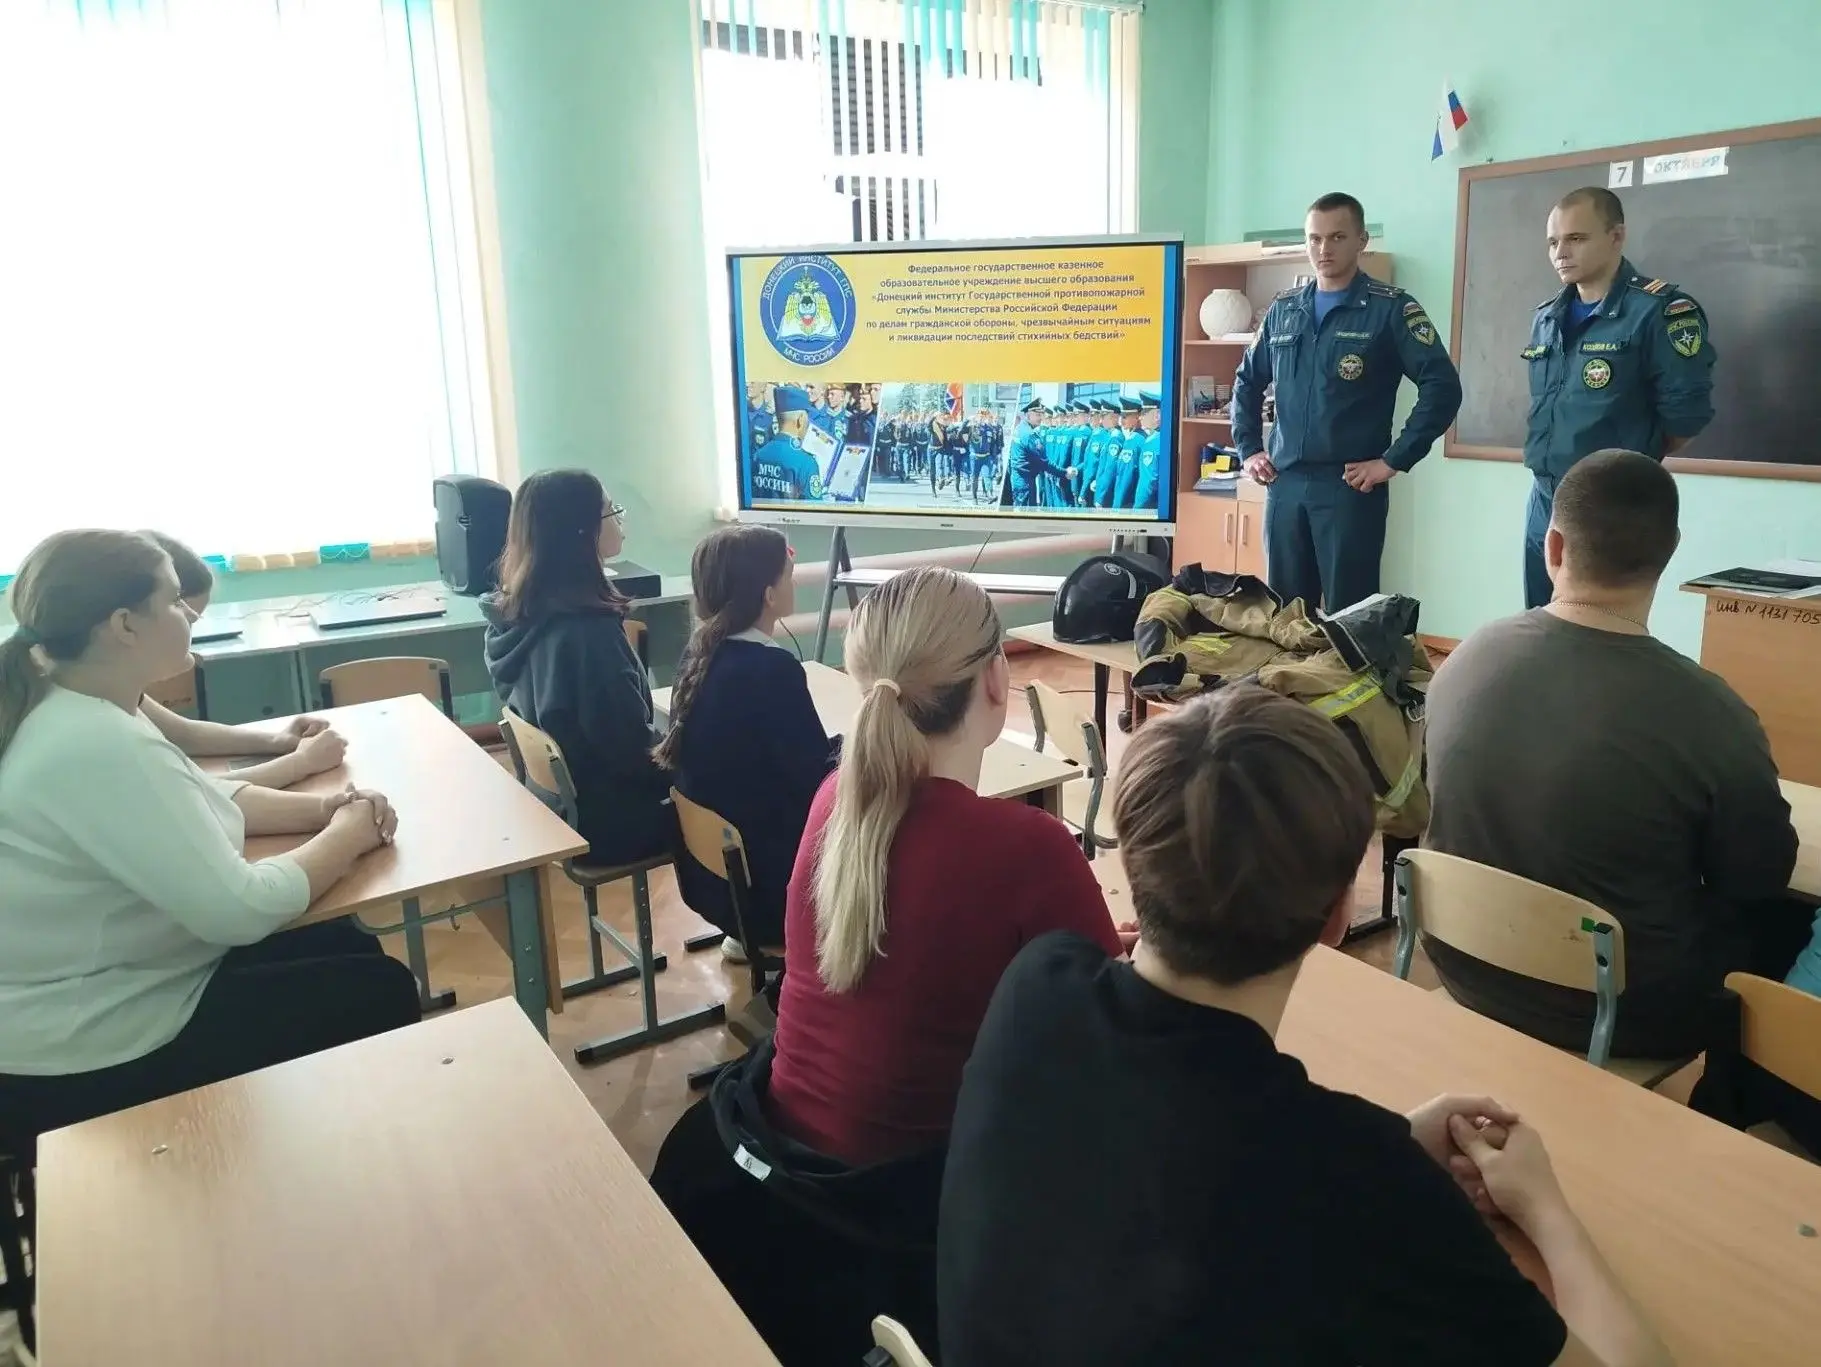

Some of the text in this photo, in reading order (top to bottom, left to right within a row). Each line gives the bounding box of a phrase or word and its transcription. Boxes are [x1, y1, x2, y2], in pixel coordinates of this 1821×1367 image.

[1616, 166, 1627, 182] 7
[908, 261, 1104, 274] Федеральное государственное казенное
[880, 274, 1135, 288] образовательное учреждение высшего образования
[872, 287, 1145, 302] «Донецкий институт Государственной противопожарной
[895, 303, 1117, 315] службы Министерства Российской Федерации
[866, 316, 1151, 329] по делам гражданской обороны, чрезвычайным ситуациям
[897, 333, 953, 343] ликвидации
[955, 332, 1015, 341] последствий
[1018, 331, 1069, 340] стихийных
[1073, 330, 1125, 341] бедствий»
[783, 348, 835, 363] МЧС РОССИИ
[758, 463, 781, 478] МЧС
[1759, 604, 1788, 620] 1131
